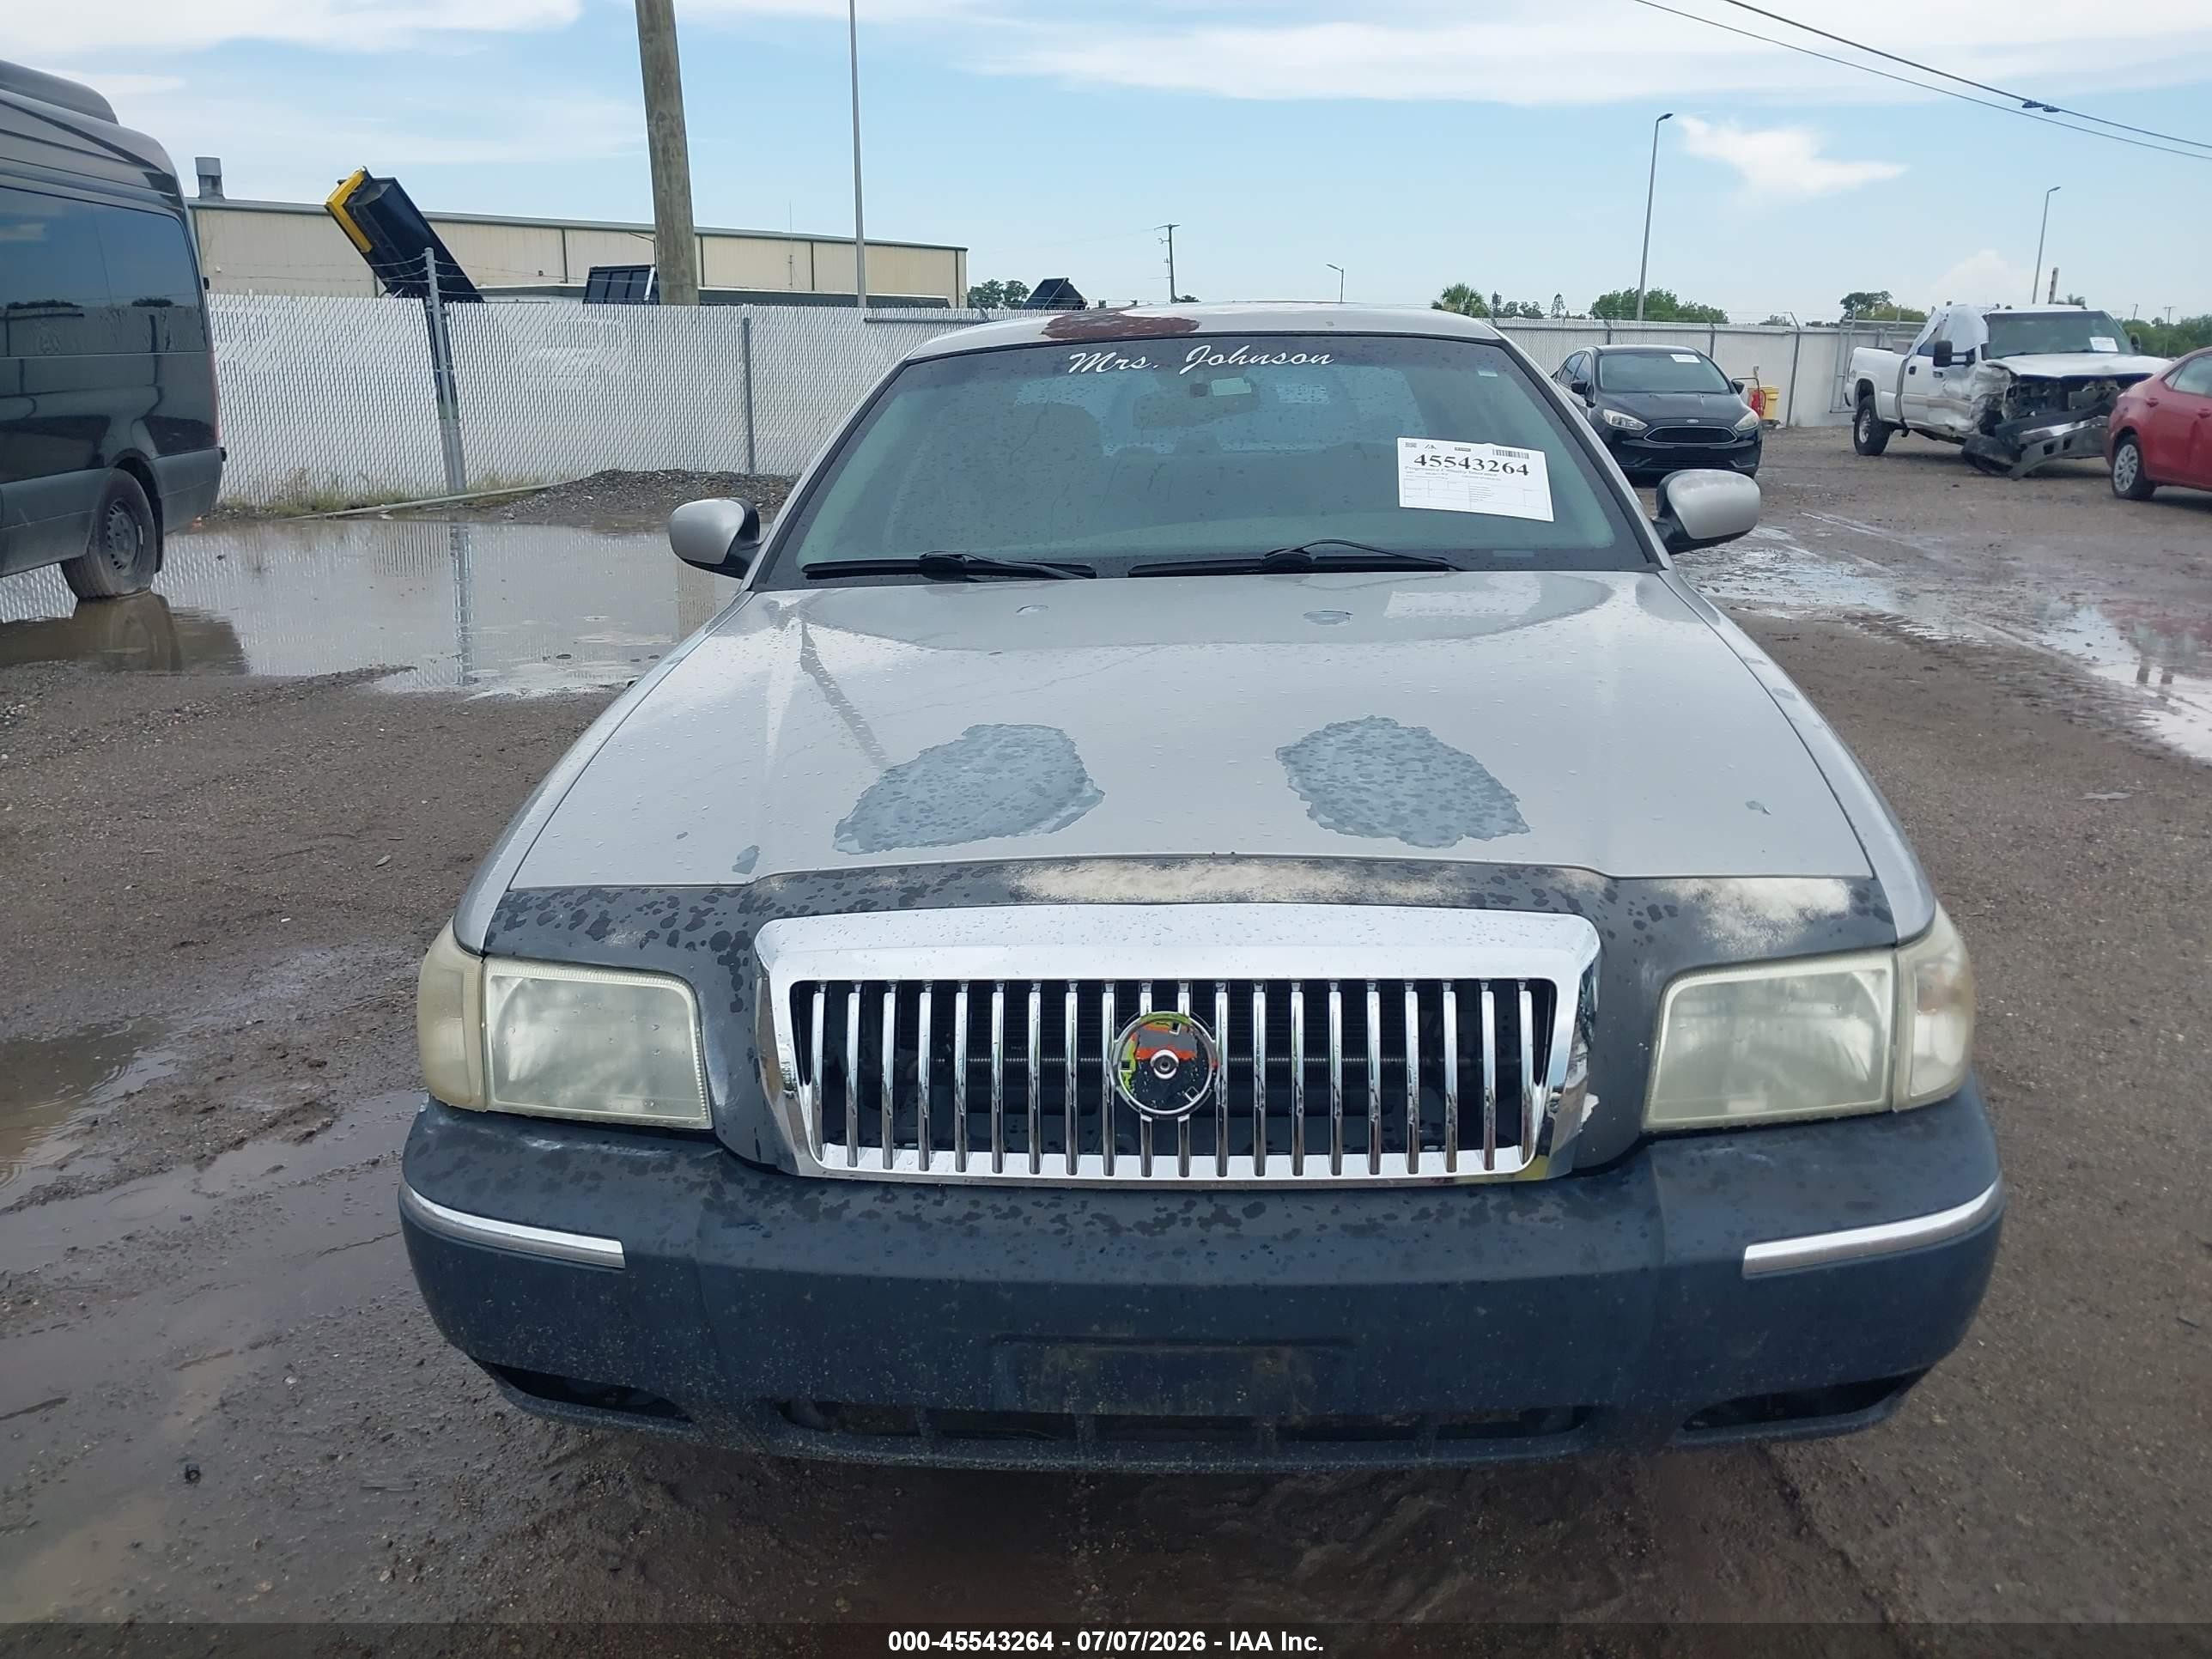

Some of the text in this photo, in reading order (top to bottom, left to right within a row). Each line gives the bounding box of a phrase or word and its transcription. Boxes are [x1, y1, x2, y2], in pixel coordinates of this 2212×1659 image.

[1068, 344, 1334, 374] Mrs. Johnson
[1413, 453, 1529, 477] 45543264
